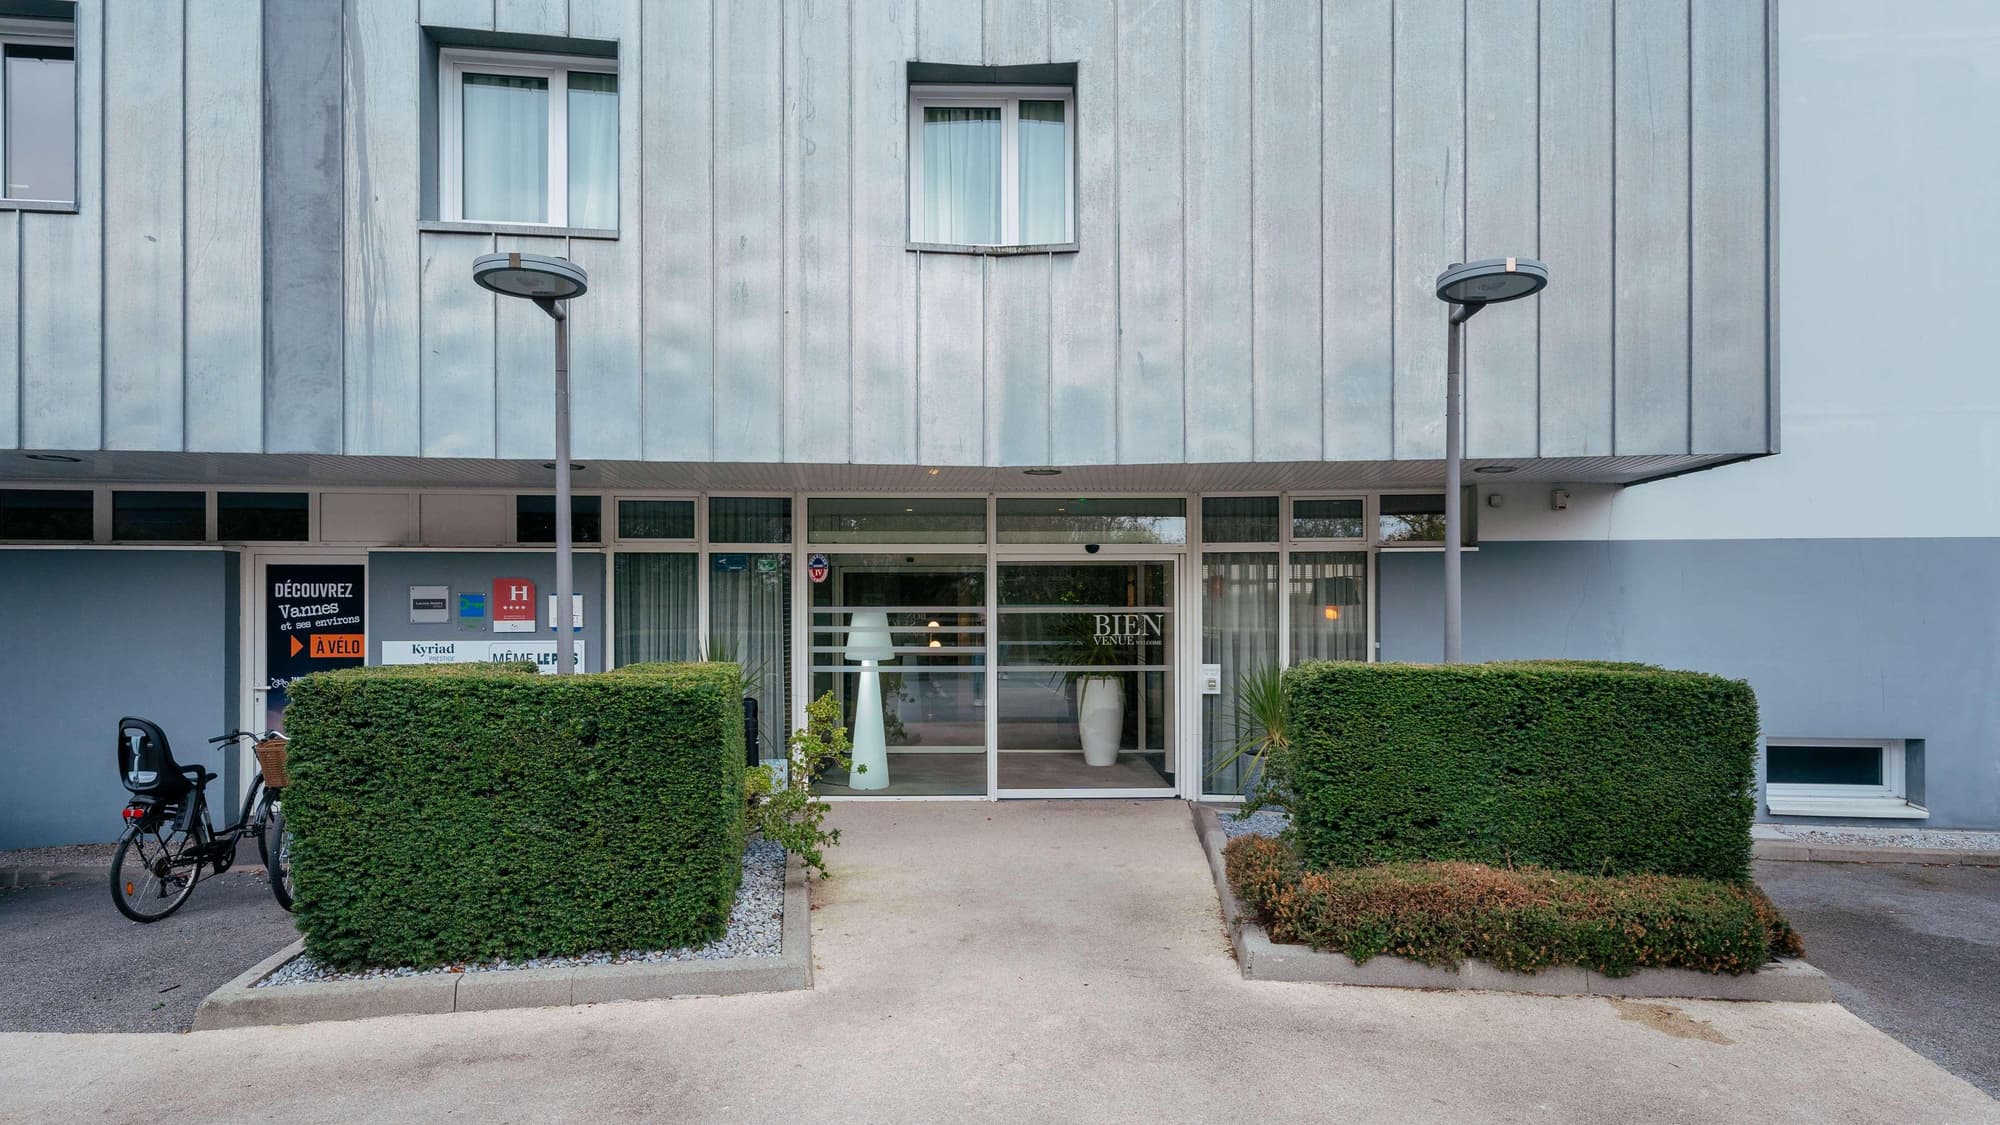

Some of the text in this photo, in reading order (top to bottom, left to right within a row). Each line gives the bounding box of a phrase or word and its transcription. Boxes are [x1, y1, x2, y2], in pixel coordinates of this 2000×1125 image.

[275, 579, 352, 598] DÉCOUVREZ
[510, 585, 528, 601] H
[278, 602, 339, 619] Vannes
[280, 616, 360, 631] et ses environs
[1093, 614, 1164, 636] BIEN
[316, 637, 360, 654] À VÉLO
[1093, 636, 1134, 646] VENUE
[412, 643, 455, 657] Kyriad
[492, 649, 534, 664] MÊME
